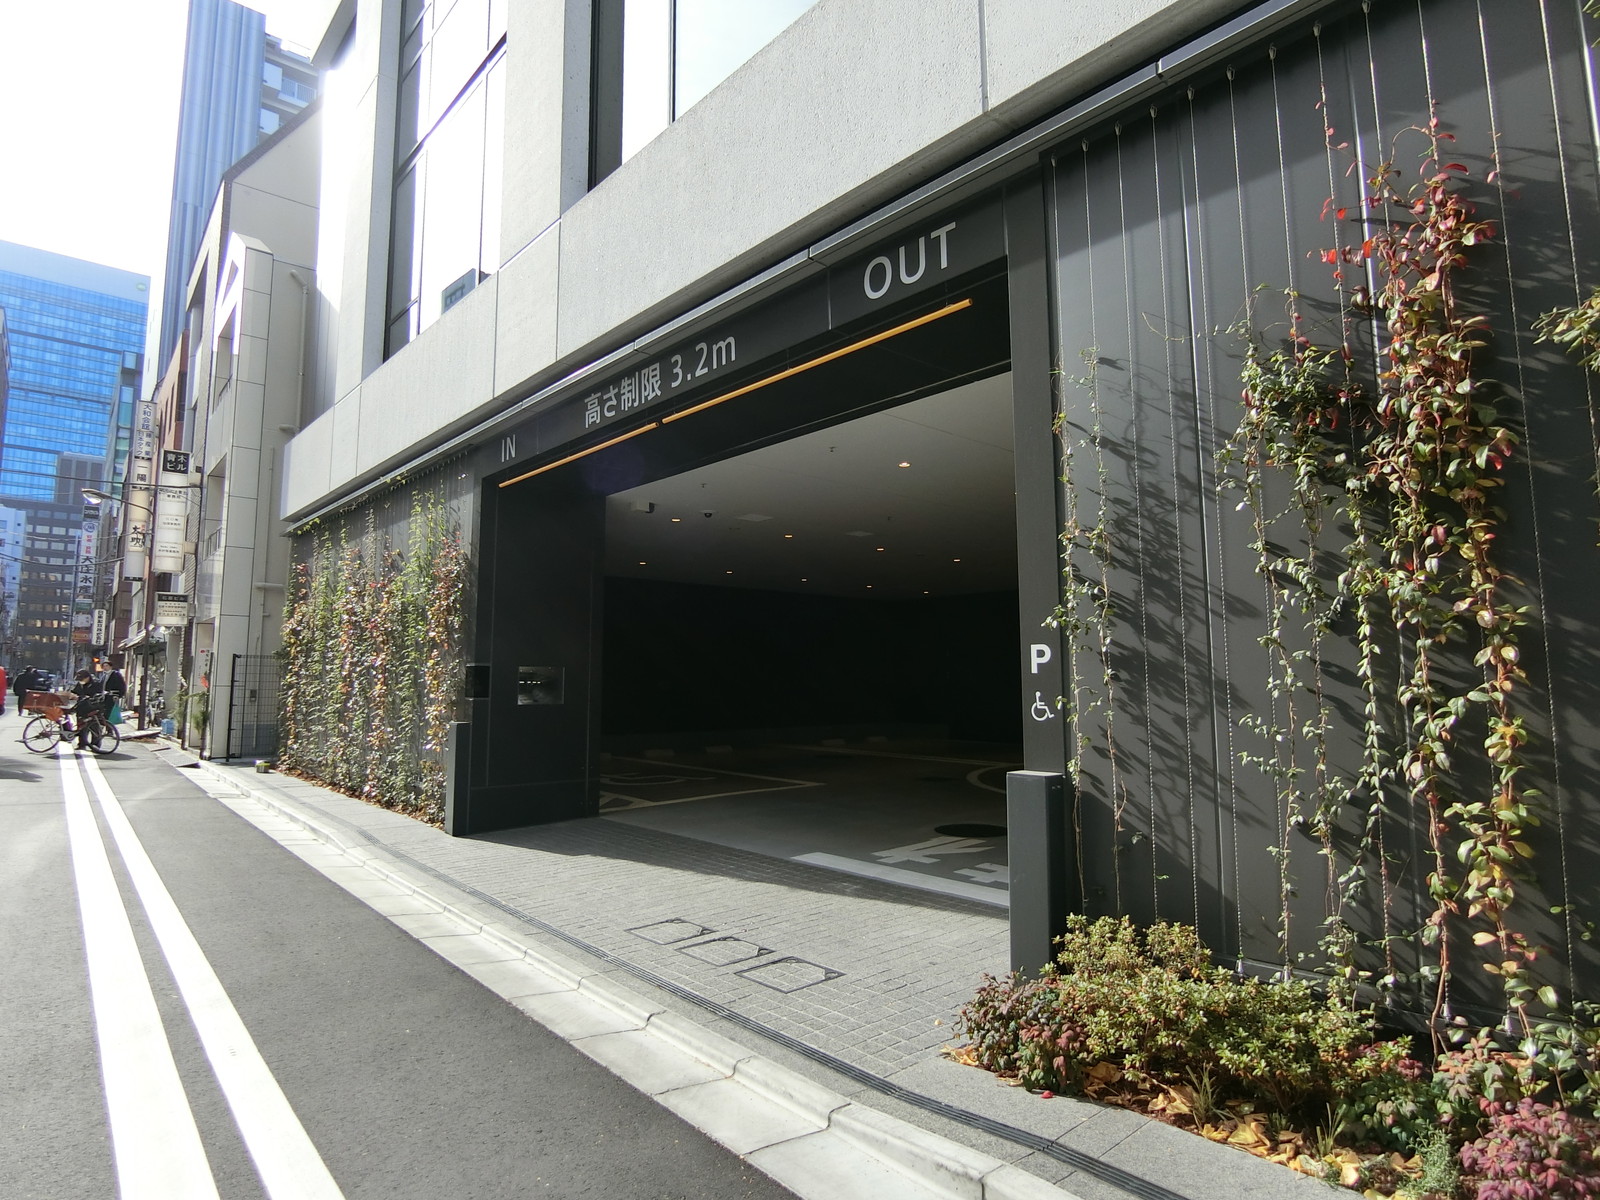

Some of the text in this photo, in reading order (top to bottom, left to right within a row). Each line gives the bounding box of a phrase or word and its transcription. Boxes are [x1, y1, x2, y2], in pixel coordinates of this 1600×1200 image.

[863, 221, 957, 301] OUT
[584, 335, 738, 429] 高さ制限 3.2m
[500, 434, 517, 464] IN
[78, 557, 93, 594] 大庄水産
[1030, 643, 1052, 674] P
